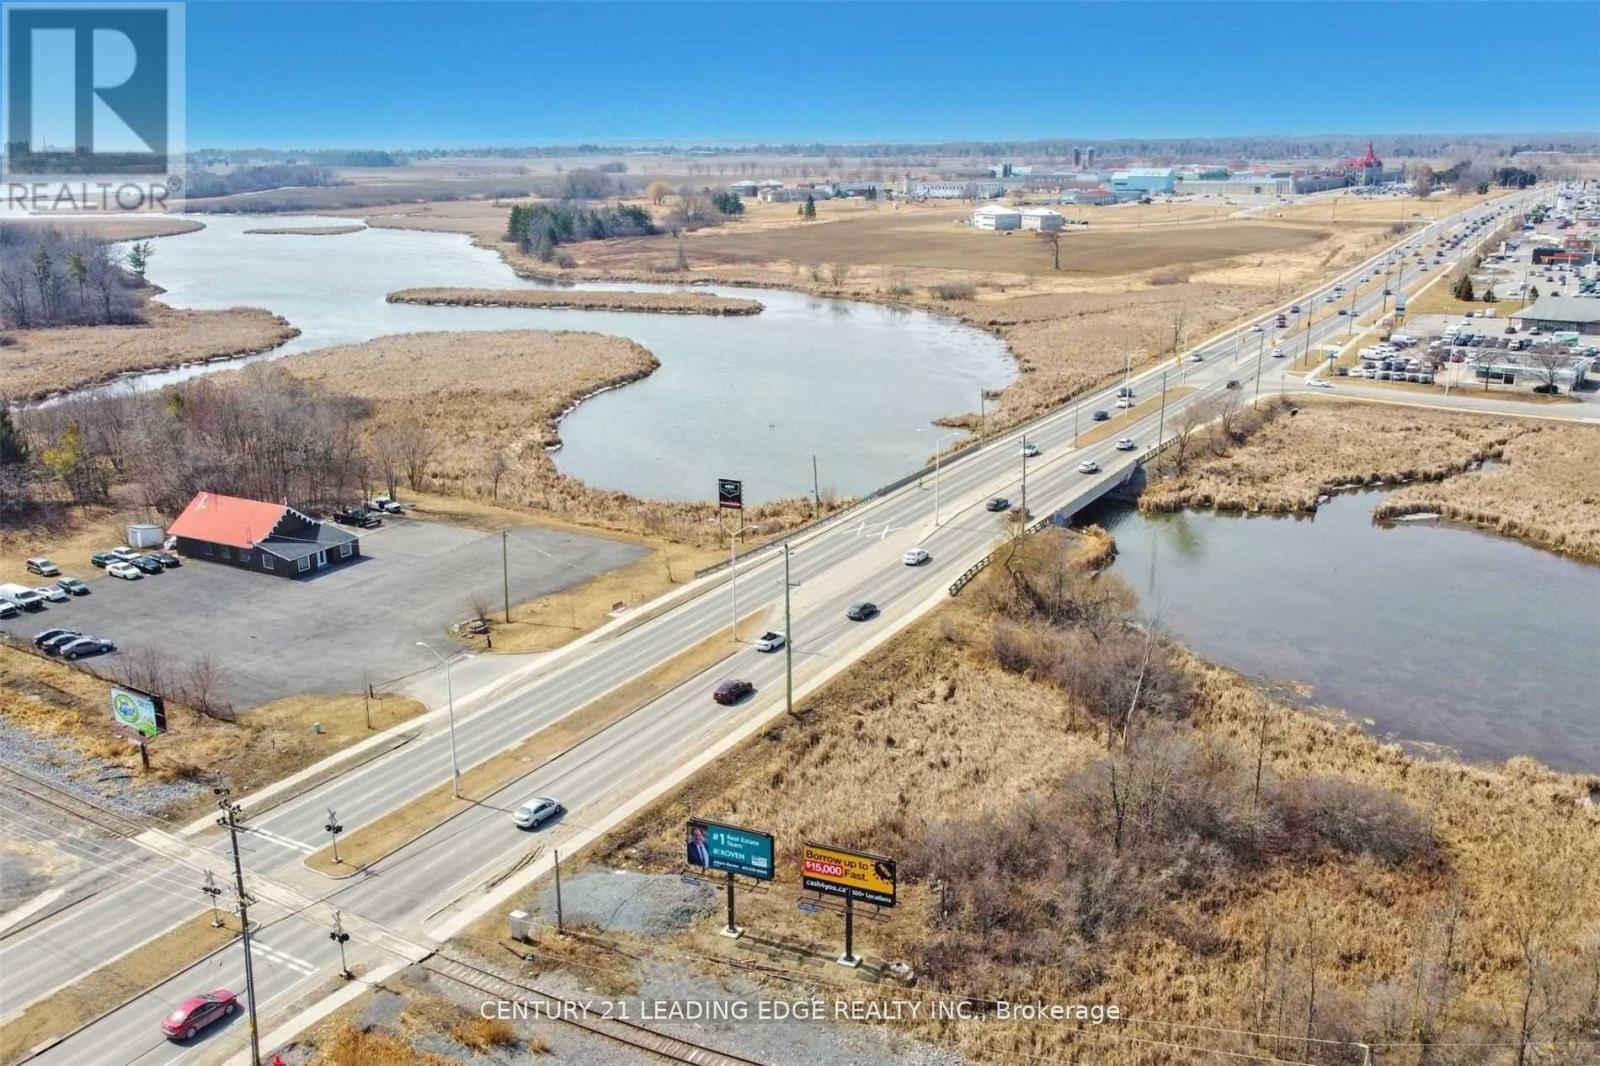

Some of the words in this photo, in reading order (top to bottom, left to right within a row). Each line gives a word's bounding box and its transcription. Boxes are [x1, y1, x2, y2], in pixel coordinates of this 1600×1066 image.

[712, 833, 725, 845] #1
[726, 834, 740, 842] Real
[741, 836, 760, 846] Estate
[726, 840, 743, 849] Team
[806, 849, 842, 864] Borrow
[844, 859, 857, 869] up
[859, 861, 869, 871] to
[805, 860, 842, 876] $15,000
[844, 869, 868, 881] Fast.
[865, 892, 892, 903] Locations
